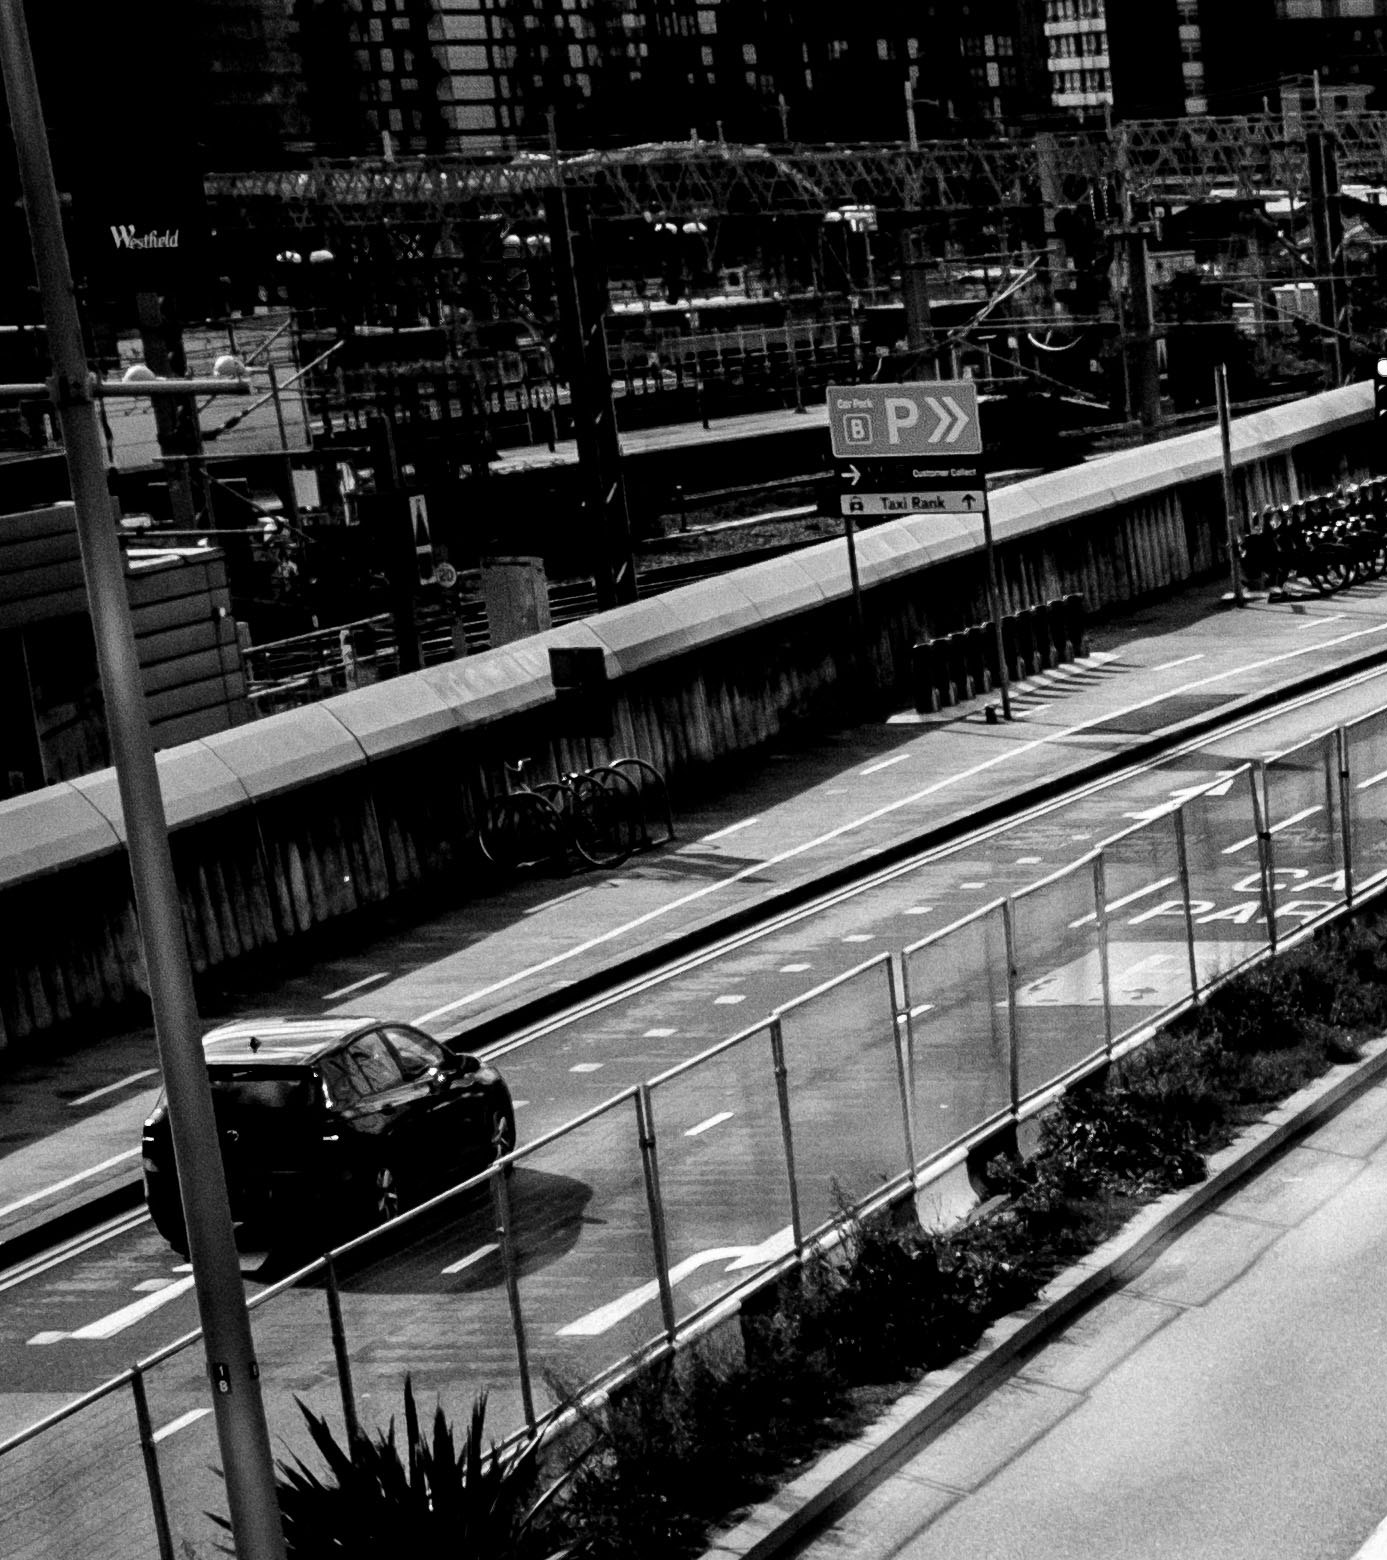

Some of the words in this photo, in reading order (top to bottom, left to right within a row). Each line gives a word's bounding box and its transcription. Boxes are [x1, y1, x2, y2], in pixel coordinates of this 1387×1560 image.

[110, 224, 179, 249] Westfield
[837, 399, 852, 409] Car
[853, 398, 874, 409] Park
[851, 419, 865, 439] B
[885, 397, 919, 445] P
[880, 496, 908, 511] Taxi
[911, 495, 946, 510] Rank
